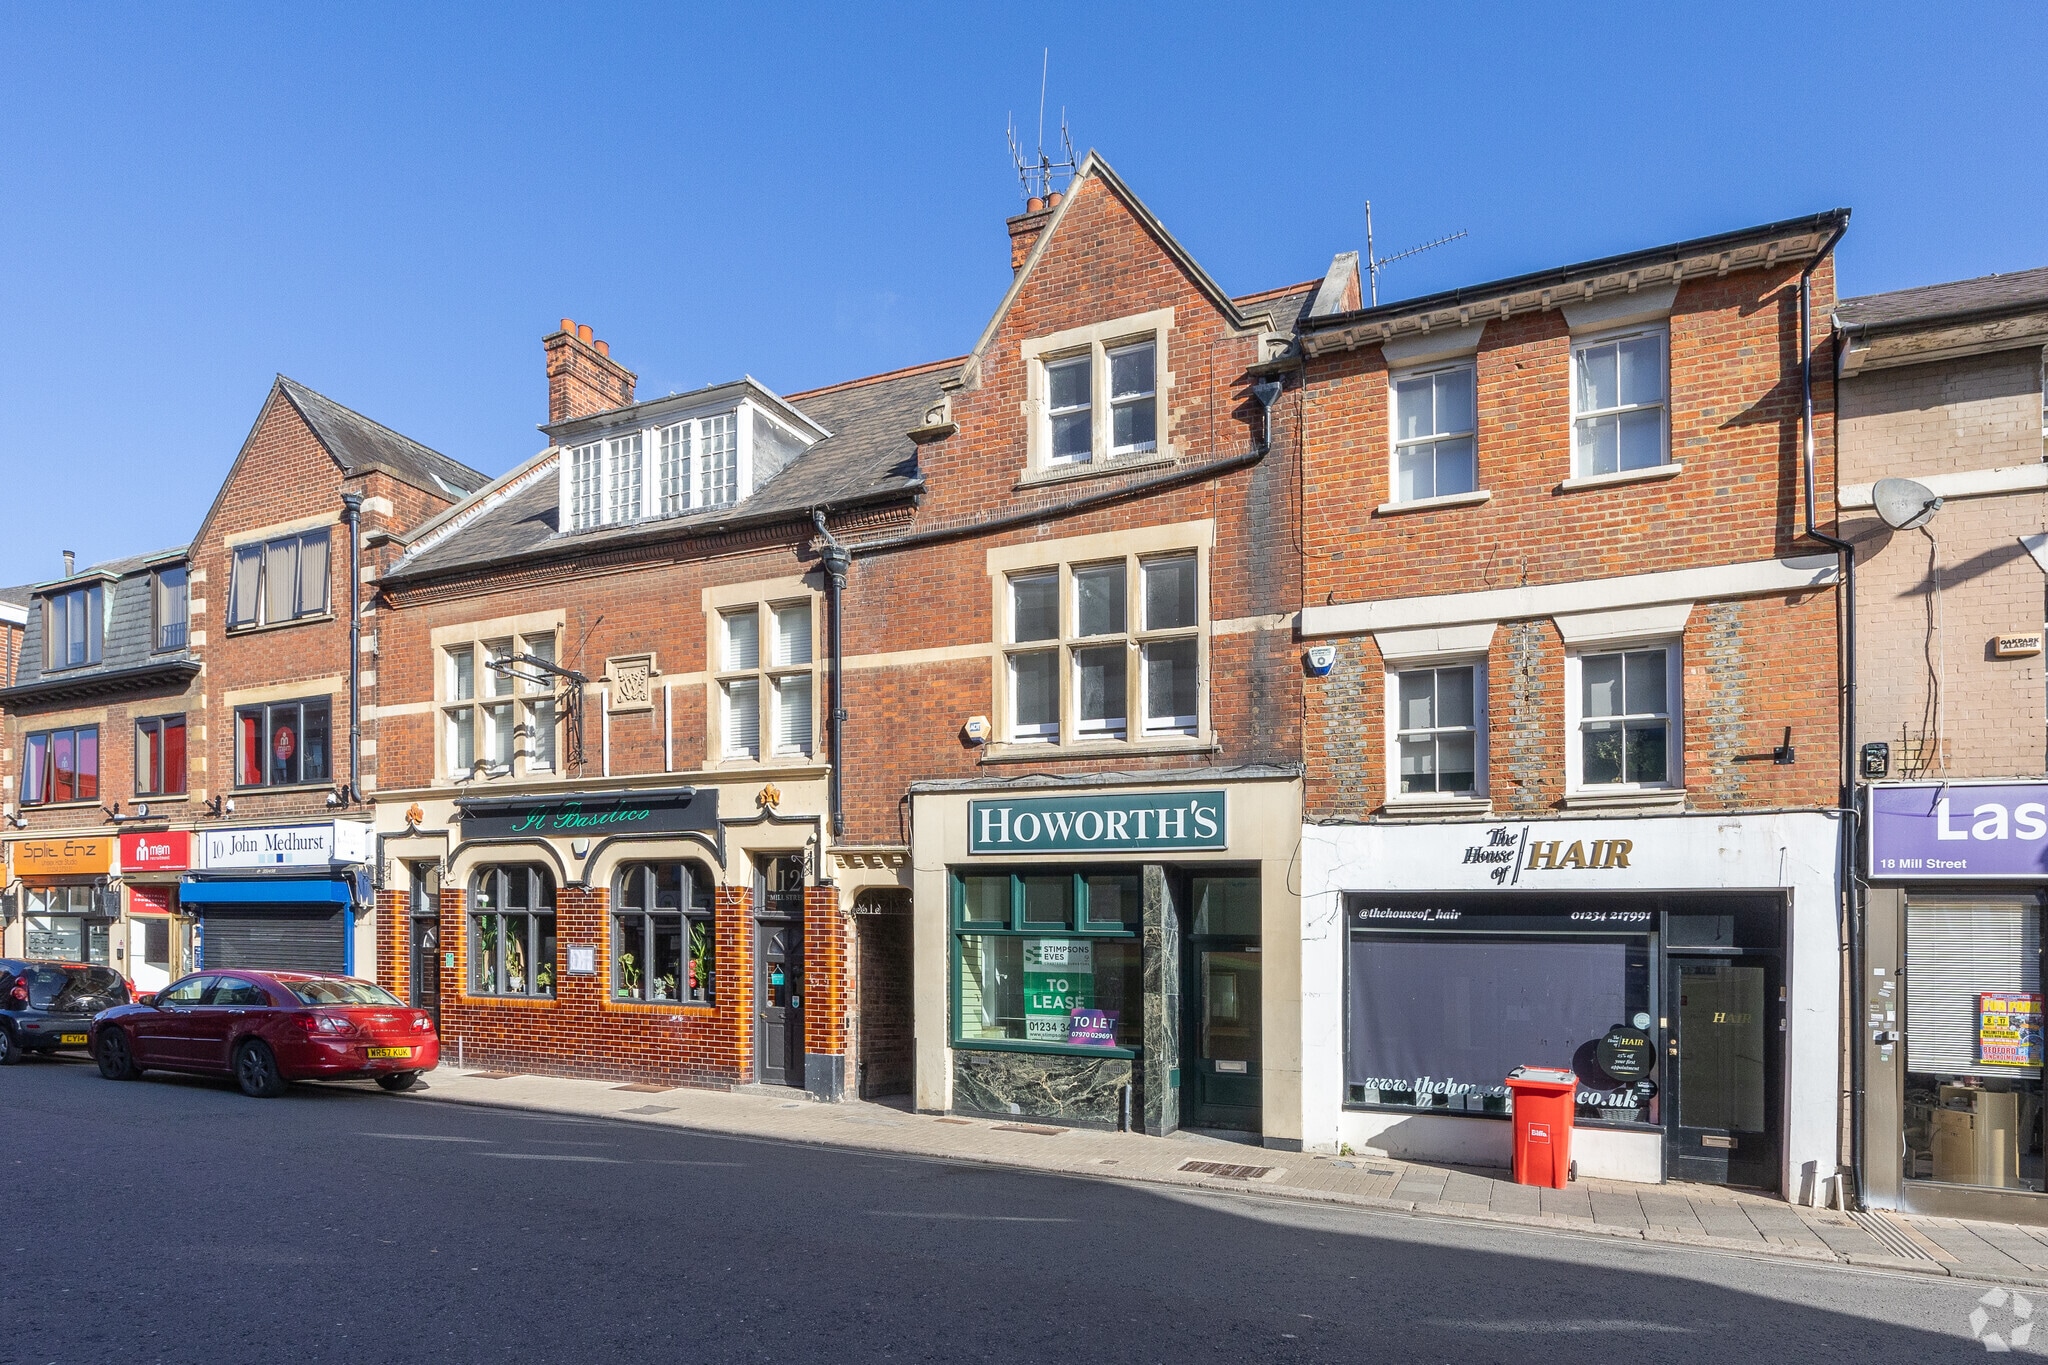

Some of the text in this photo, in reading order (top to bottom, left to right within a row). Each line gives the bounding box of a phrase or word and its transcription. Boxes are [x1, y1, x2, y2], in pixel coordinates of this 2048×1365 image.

[2000, 637, 2039, 645] OAKPARK
[2003, 642, 2037, 650] ALARMS
[512, 800, 650, 832] Il Basilico
[978, 800, 1218, 843] HOWORTH'S
[1937, 797, 2048, 841] Las
[1486, 826, 1518, 847] The
[23, 840, 96, 863] Split Enz
[213, 840, 224, 859] 10
[229, 834, 258, 856] John
[265, 832, 324, 851] Medhurst
[1462, 846, 1515, 864] House
[1524, 838, 1633, 870] HAIR
[1880, 859, 1967, 869] 18 Mill Street
[778, 869, 800, 892] 12
[1490, 864, 1511, 886] of
[1359, 907, 1461, 921] @thehouseof_hair
[1570, 911, 1652, 921] 01234 217991
[1044, 953, 1065, 961] EVES
[1046, 978, 1069, 993] TO
[1033, 995, 1085, 1010] LEASE
[1983, 1000, 2041, 1013] FUN PARK
[1073, 1016, 1115, 1029] TO LET
[1712, 1012, 1752, 1024] HAIR
[1029, 1021, 1057, 1032] 01234
[66, 1034, 85, 1042] CY14
[1621, 1038, 1644, 1046] HAIR
[370, 1048, 408, 1056] WR57 KUK
[1983, 1046, 2016, 1054] BEDFORD
[1531, 1129, 1547, 1137] Biffa
